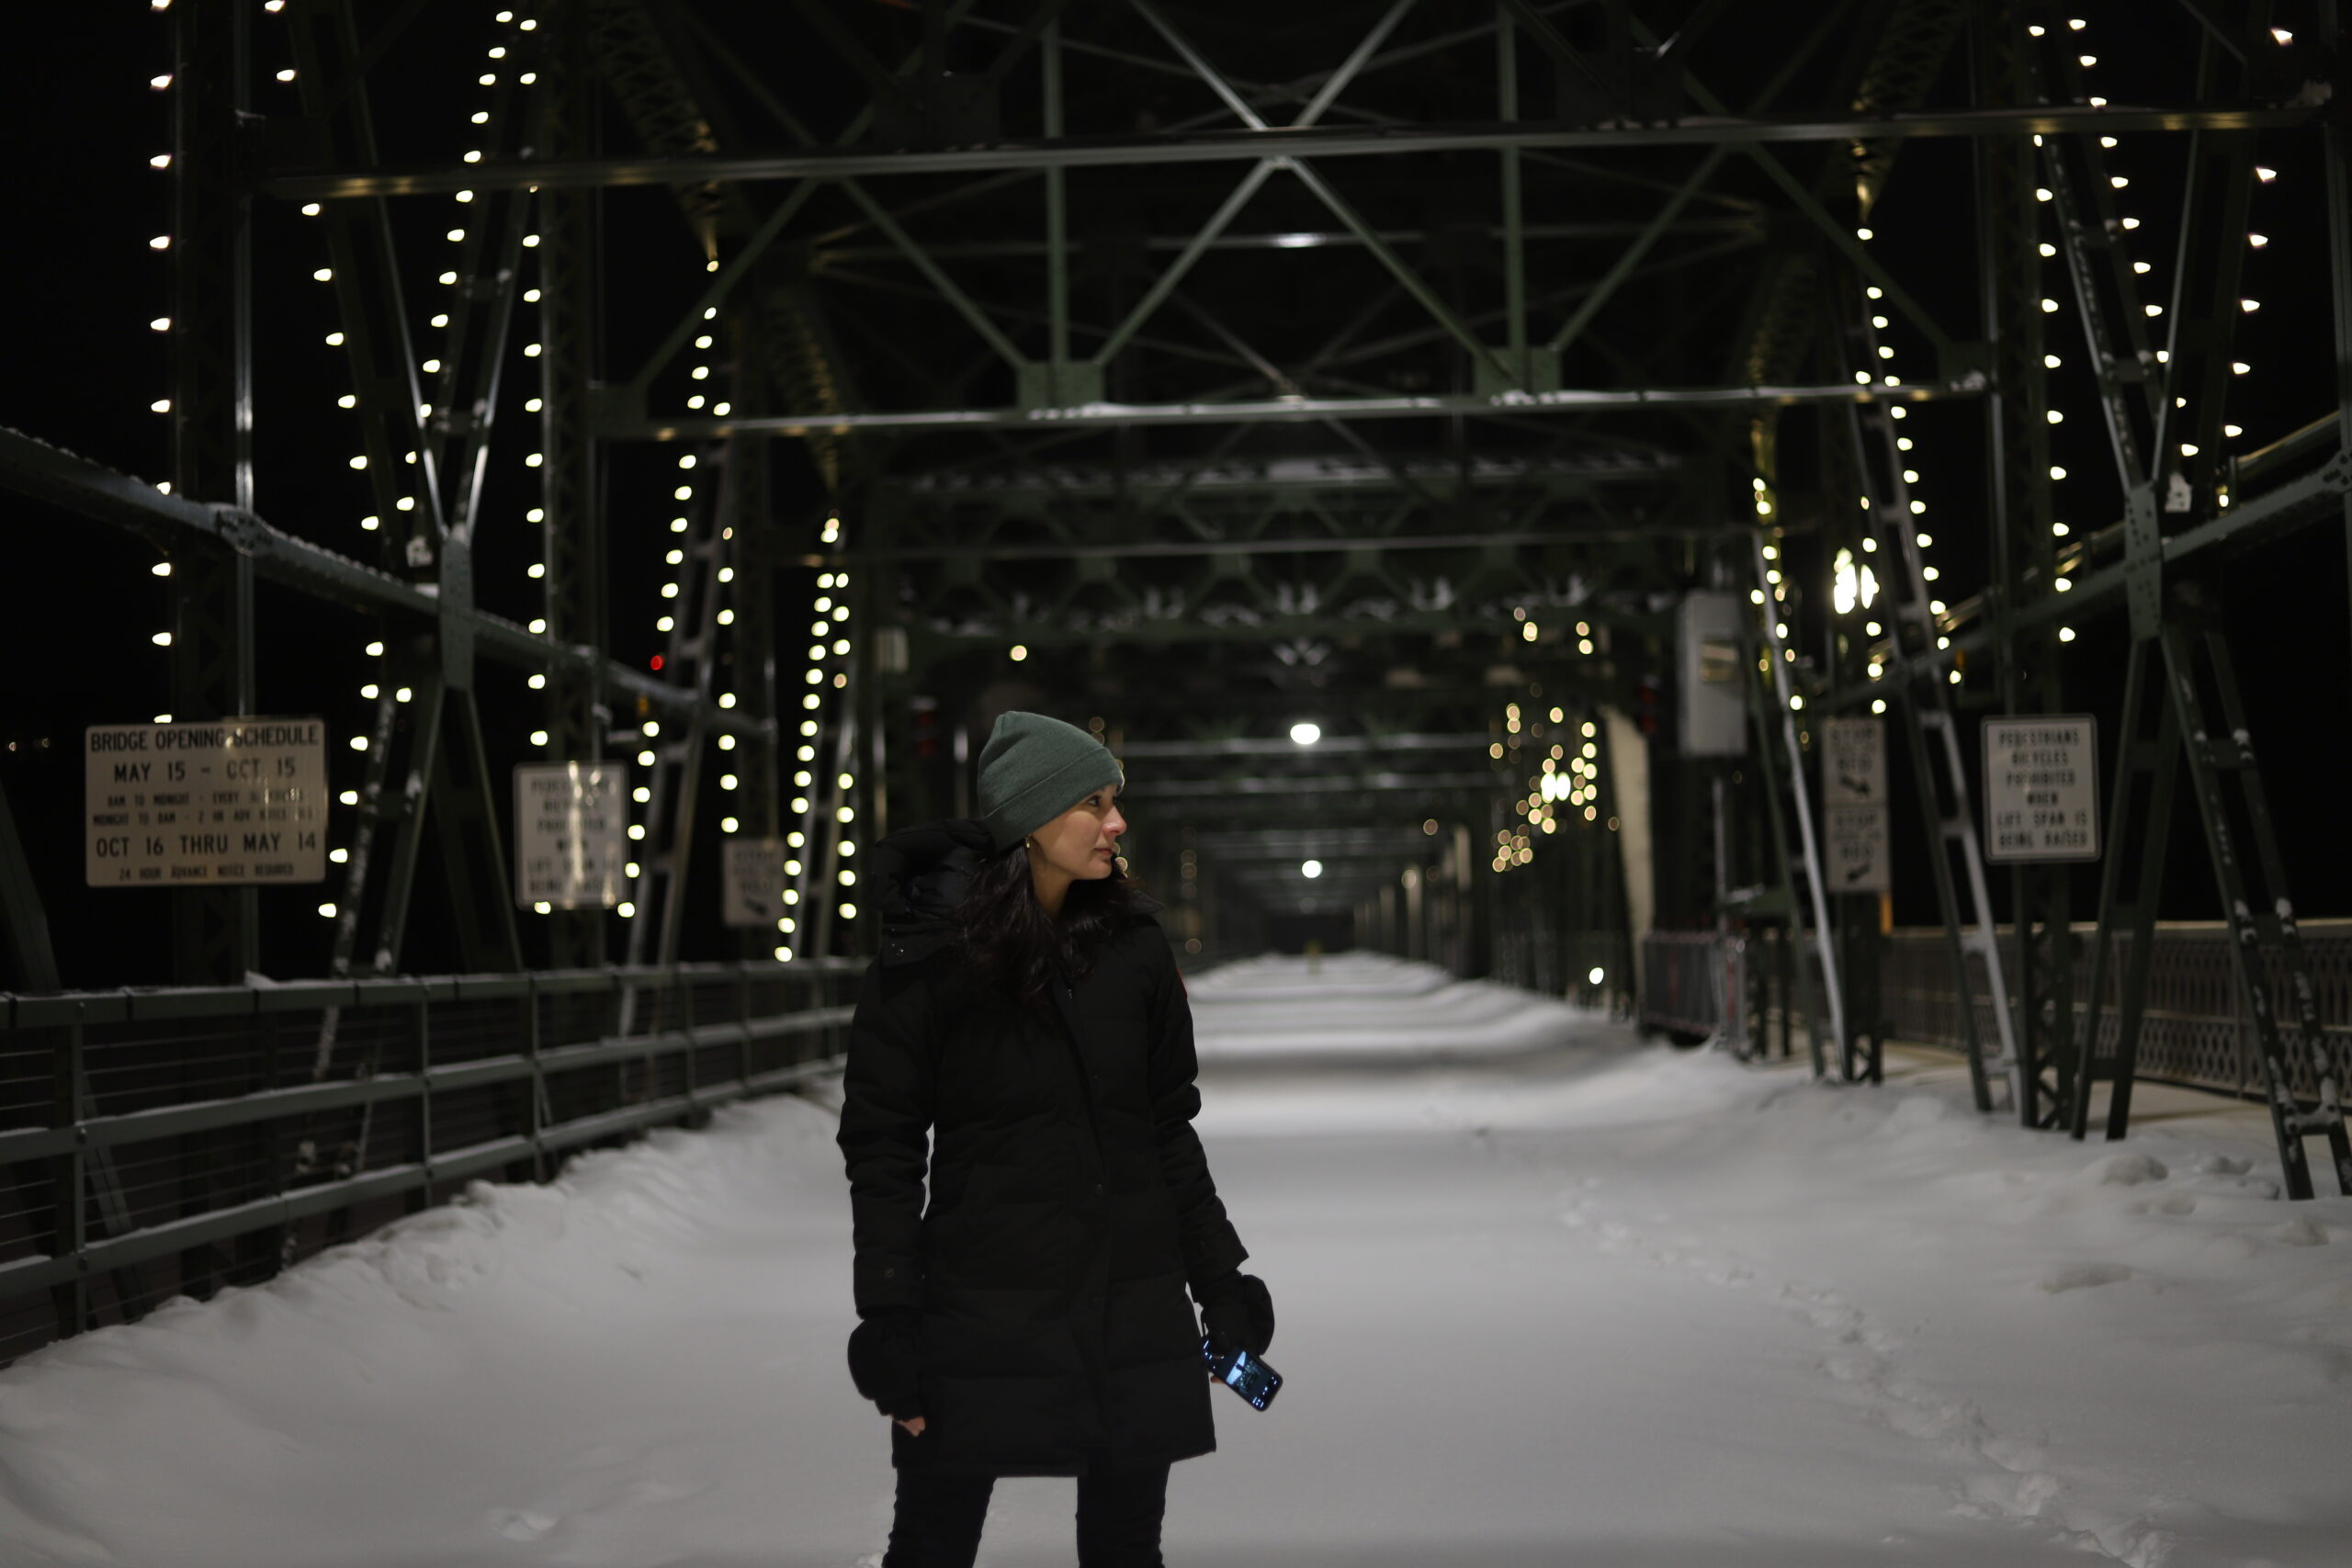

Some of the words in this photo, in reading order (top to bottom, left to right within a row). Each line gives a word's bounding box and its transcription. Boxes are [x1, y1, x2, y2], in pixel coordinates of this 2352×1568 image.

[91, 731, 149, 752] BRIDGE
[154, 728, 226, 750] OPENING
[232, 725, 319, 748] SCHEDULE
[114, 762, 152, 783] MAY
[168, 761, 186, 781] 15
[227, 758, 261, 779] OCT
[277, 756, 296, 778] 15
[96, 837, 130, 857] OCT
[146, 836, 164, 856] 16
[179, 833, 228, 855] THRU
[243, 831, 281, 852] MAY
[299, 829, 316, 852] 14
